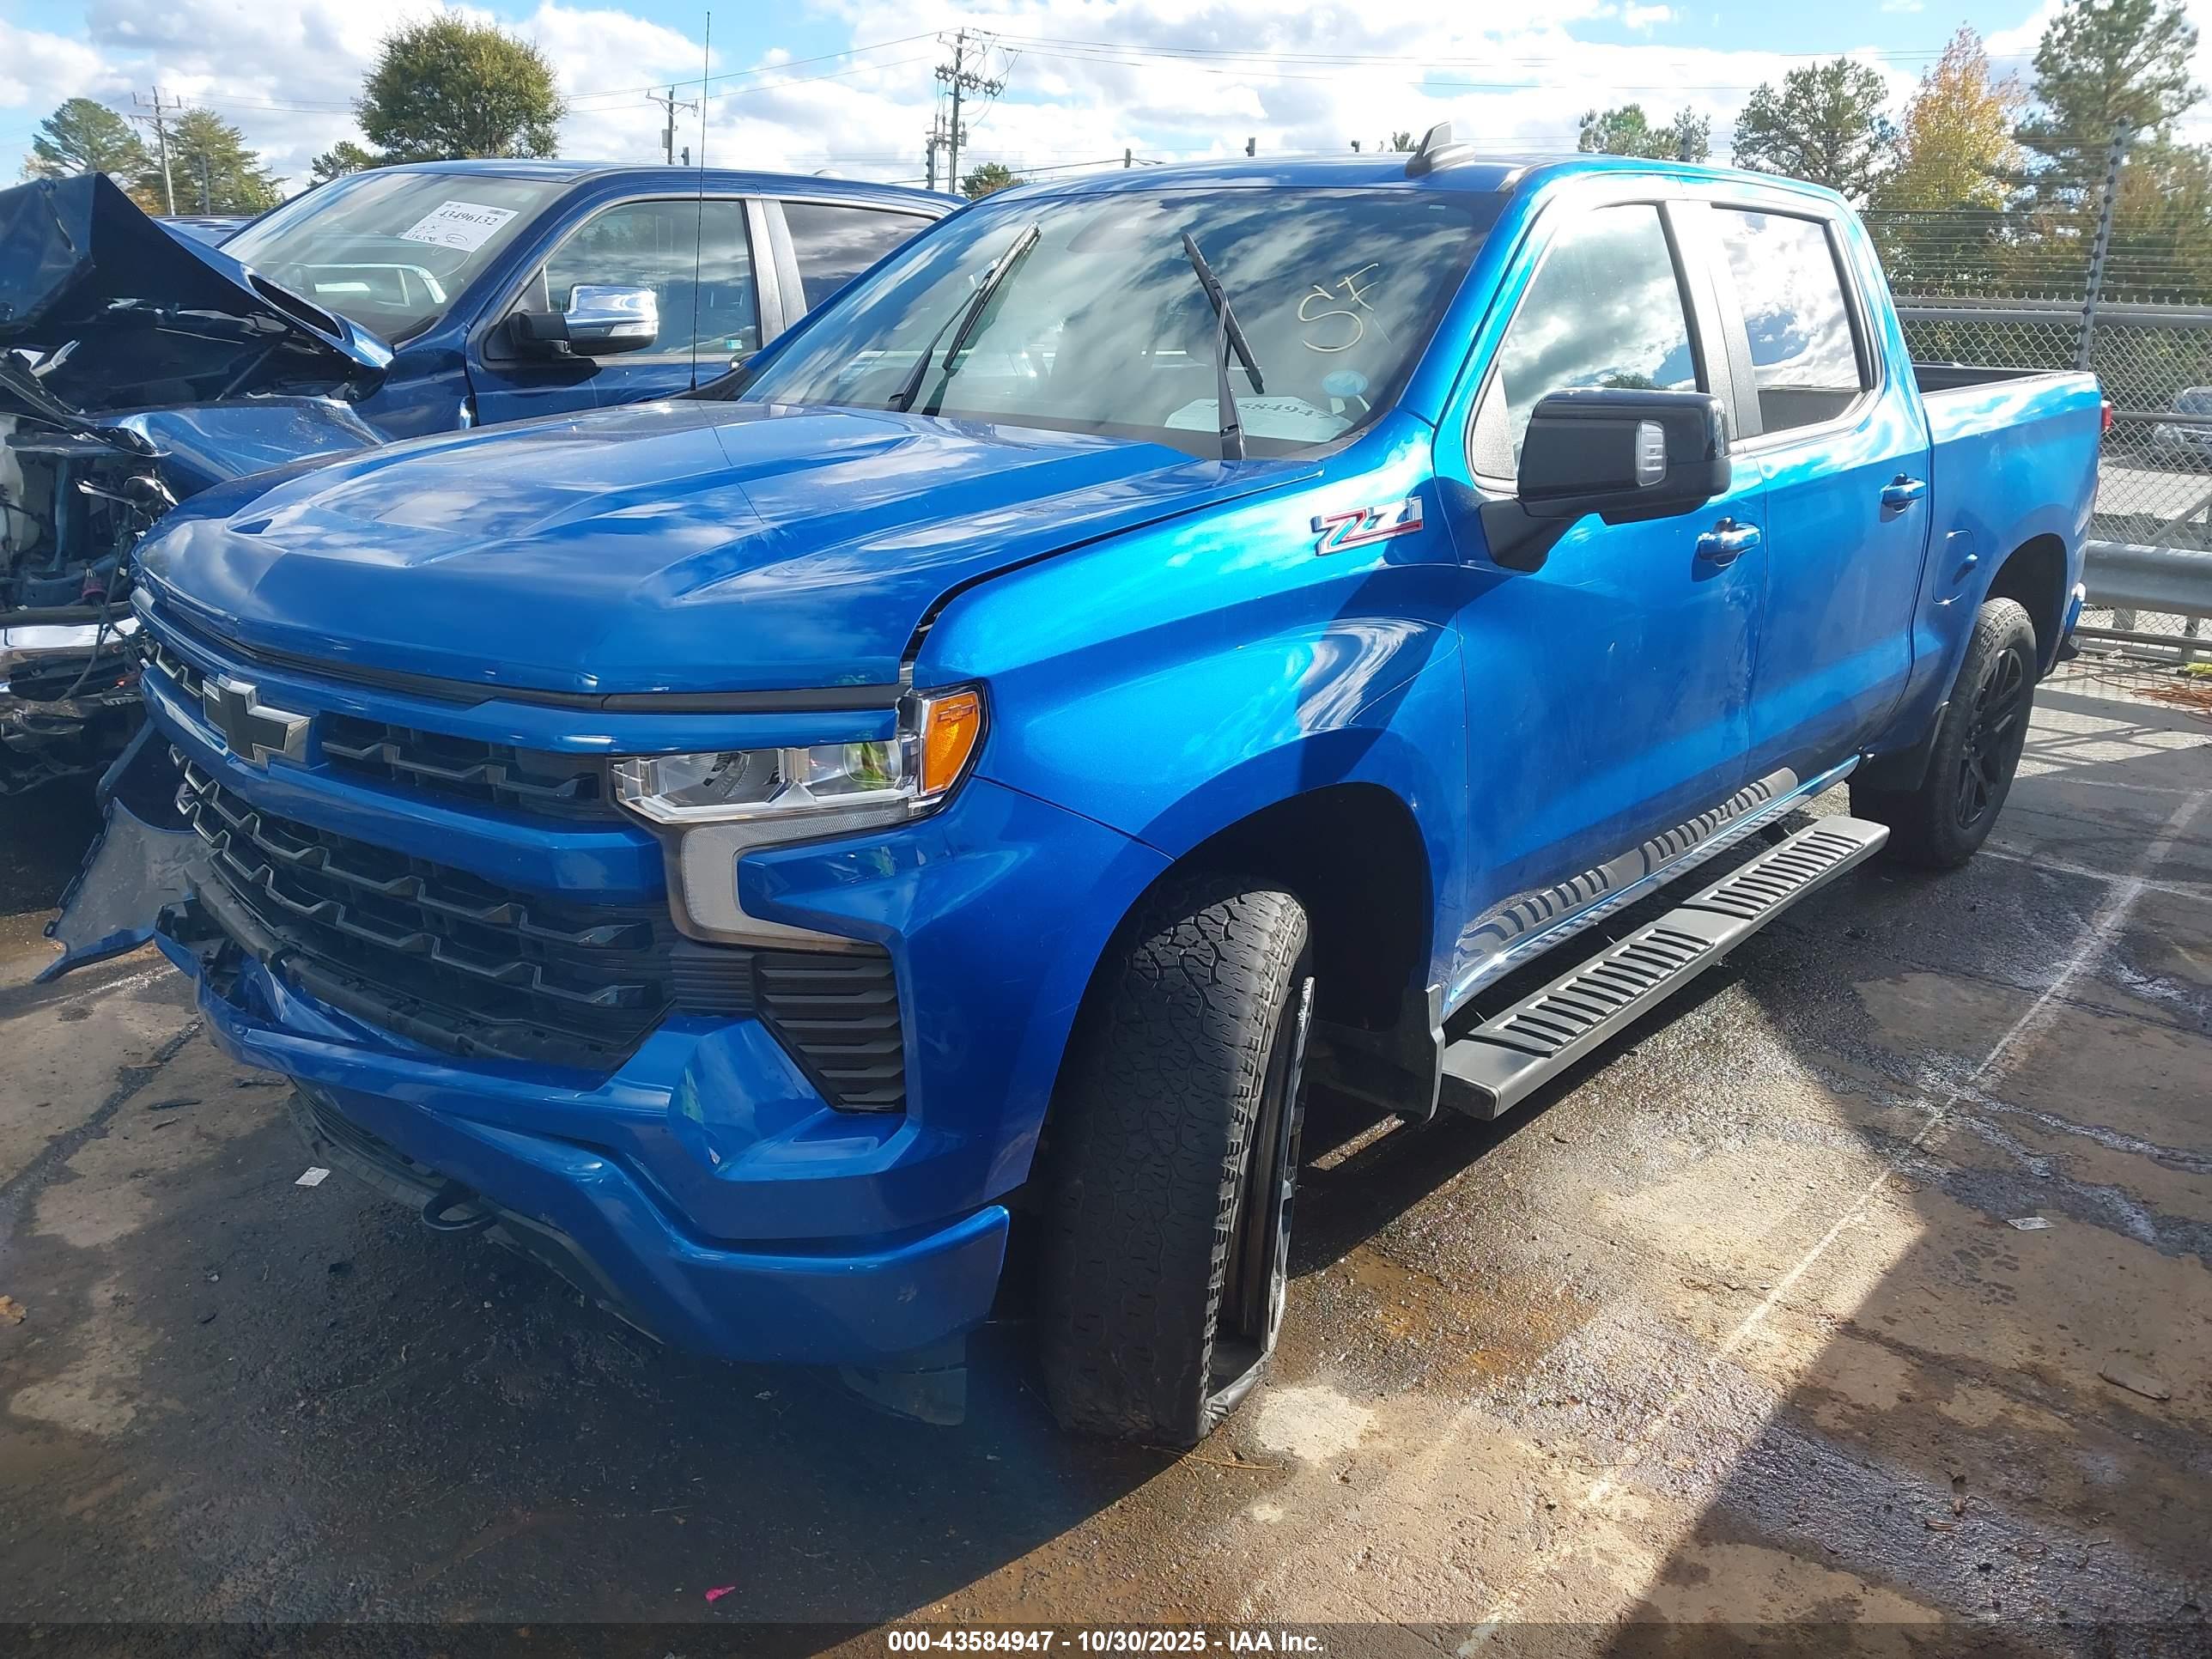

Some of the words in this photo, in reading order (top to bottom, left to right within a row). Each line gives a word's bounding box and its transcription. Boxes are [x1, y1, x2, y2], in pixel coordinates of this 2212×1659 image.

[438, 210, 498, 226] 43496132
[1206, 402, 1332, 420] 4584947
[1310, 495, 1423, 557] Z71
